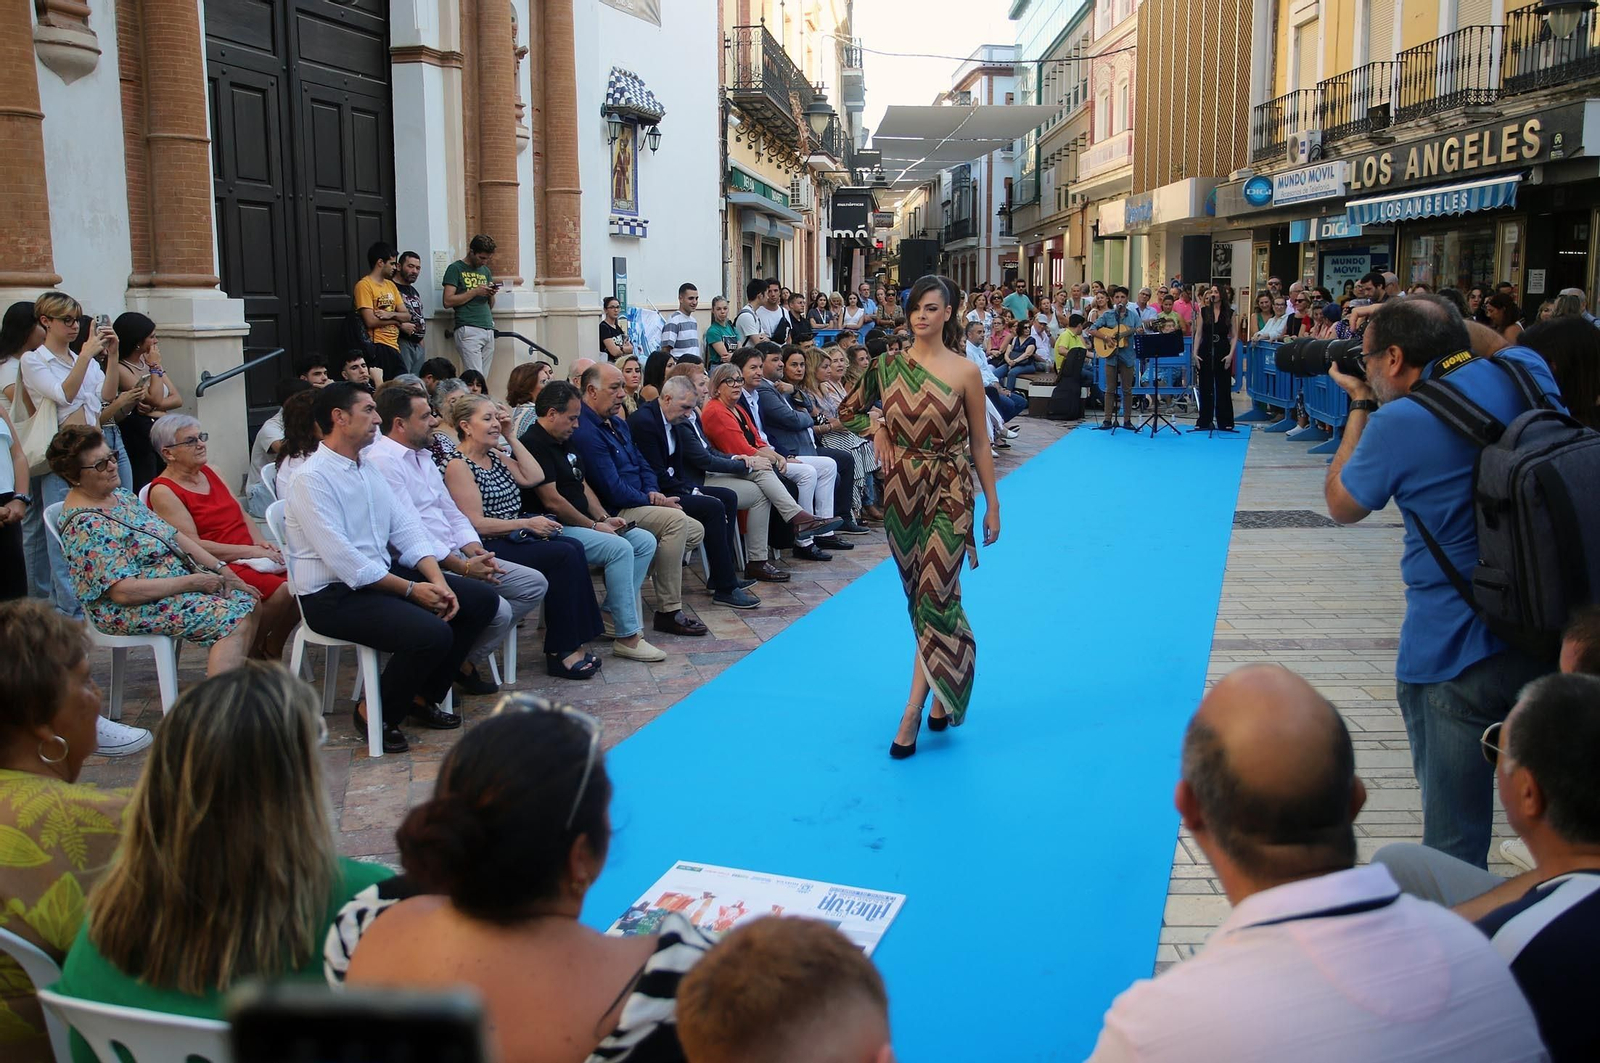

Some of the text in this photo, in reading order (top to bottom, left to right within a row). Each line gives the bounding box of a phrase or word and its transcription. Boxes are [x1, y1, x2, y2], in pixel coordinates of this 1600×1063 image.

[1351, 118, 1541, 190] LOS ANGELES
[1277, 171, 1307, 189] MUNDO
[1380, 192, 1468, 218] LOS ANGELES
[1321, 221, 1348, 237] DIGI
[1331, 257, 1366, 266] MUNDO
[1442, 351, 1471, 369] Nikon
